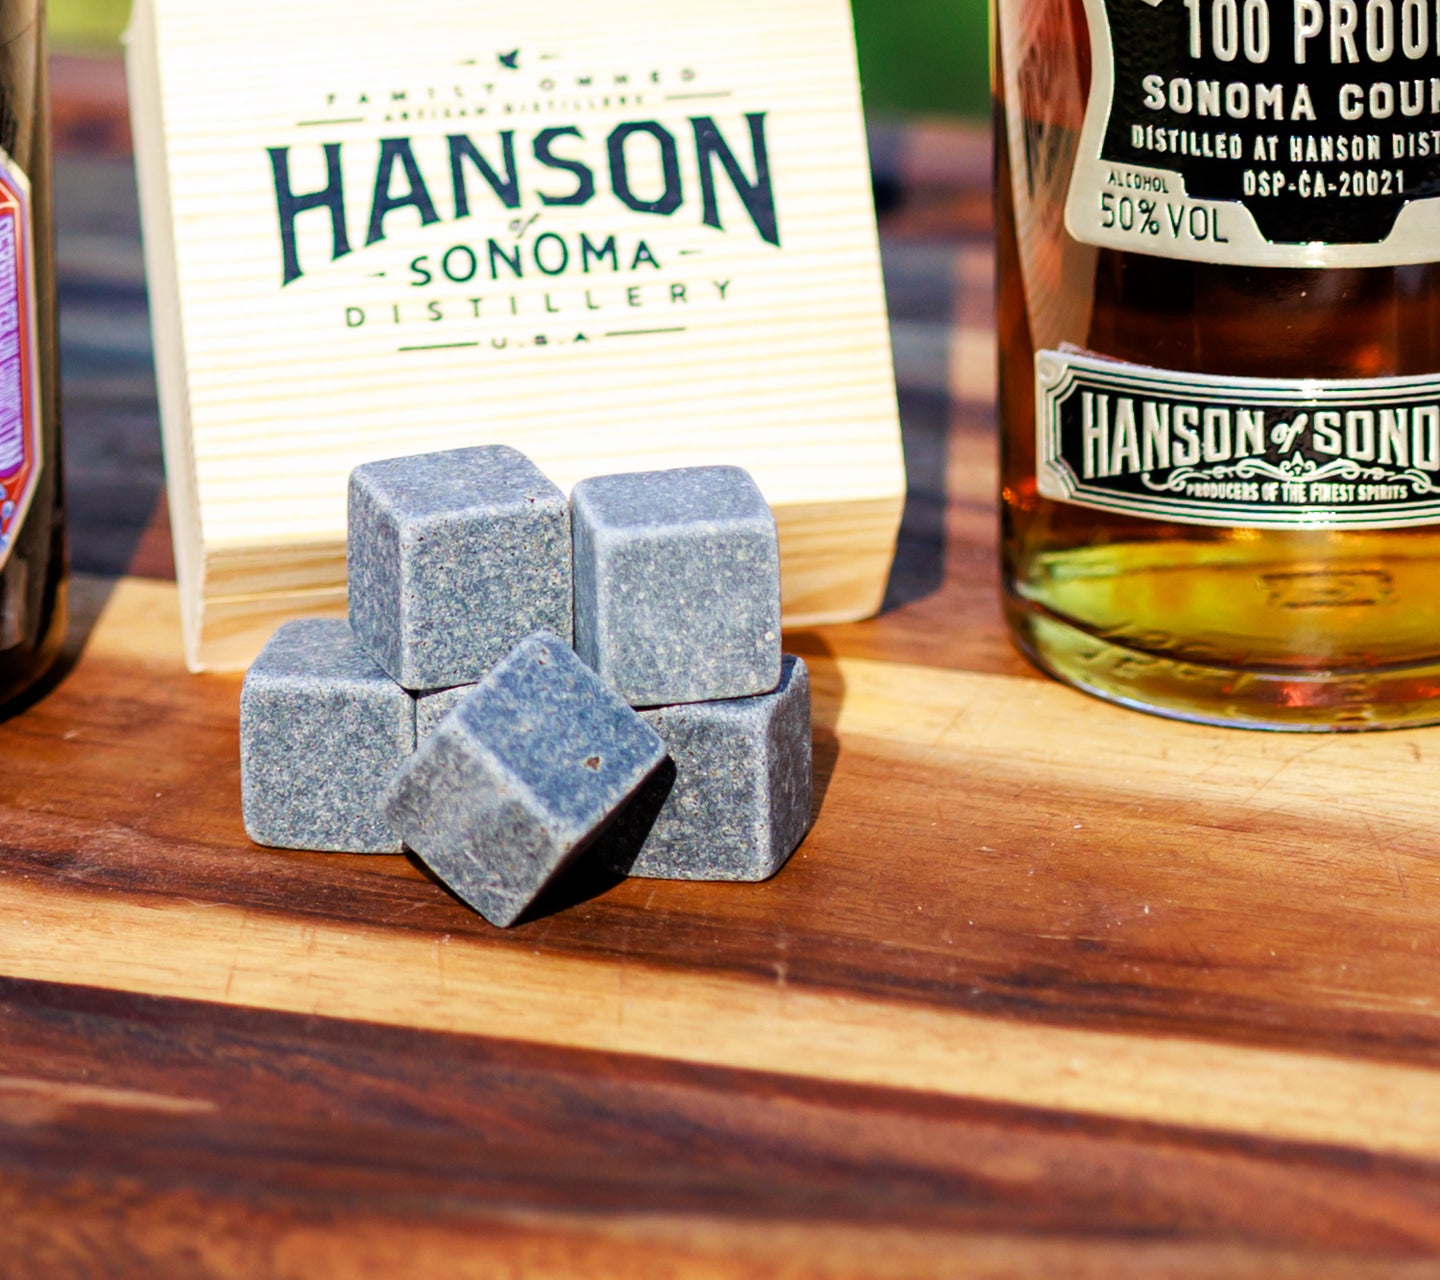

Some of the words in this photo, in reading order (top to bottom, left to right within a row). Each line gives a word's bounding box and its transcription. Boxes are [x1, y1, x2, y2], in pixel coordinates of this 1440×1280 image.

[1143, 74, 1317, 122] SONOMA
[1130, 123, 1242, 161] DISTILLED
[1254, 134, 1279, 161] AT
[1290, 133, 1381, 162] HANSON
[266, 111, 782, 288] HANSON
[1106, 169, 1169, 193] ALCOHOL
[1242, 169, 1405, 196] DSP-CA-20021
[509, 212, 541, 240] of
[408, 230, 661, 289] SONOMA
[345, 279, 734, 330] DISTILLERY
[491, 330, 589, 350] U.S.A
[1081, 391, 1266, 482] HANSON
[1269, 412, 1308, 454] of
[1186, 482, 1259, 501] PRODUCERS
[1261, 482, 1279, 502] OF
[1281, 482, 1306, 503] THE
[1310, 483, 1355, 502] FINEST
[1358, 484, 1409, 501] SPIRITS
